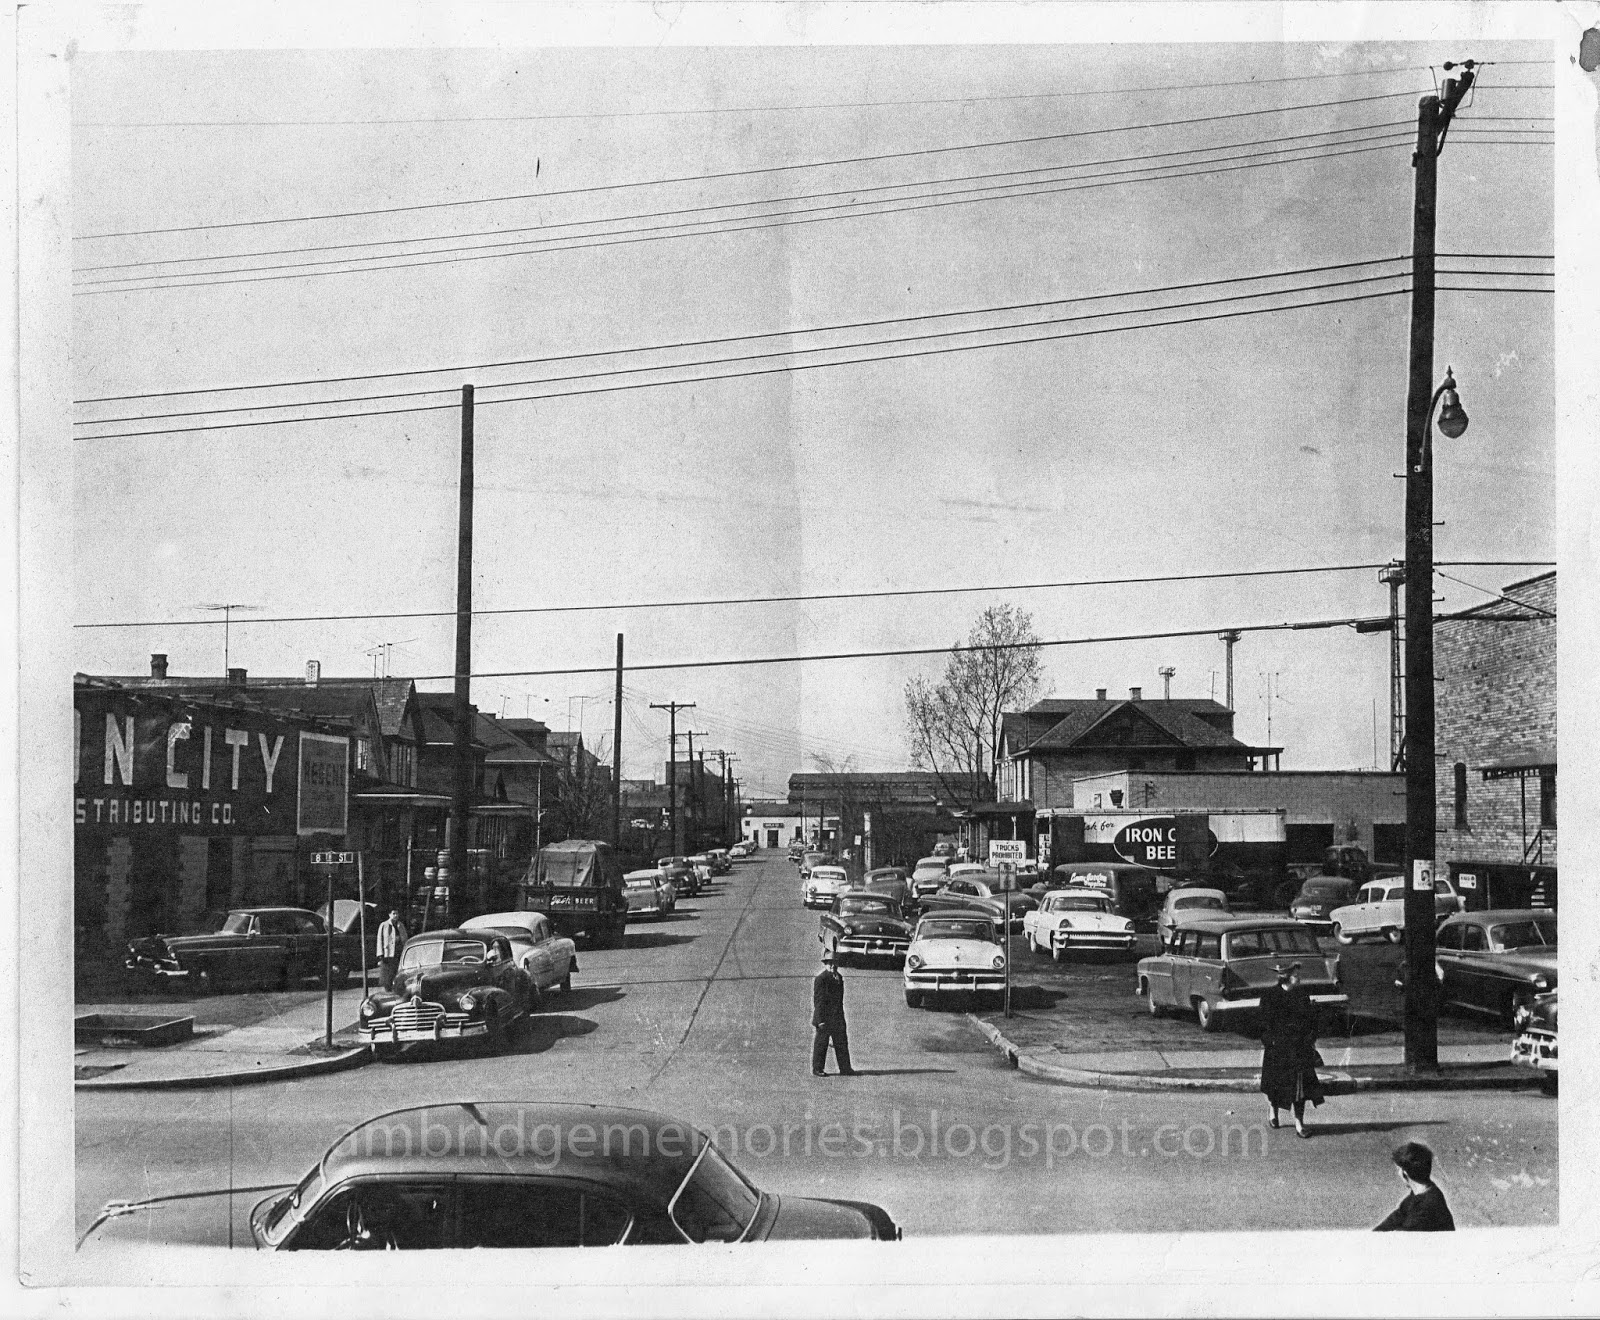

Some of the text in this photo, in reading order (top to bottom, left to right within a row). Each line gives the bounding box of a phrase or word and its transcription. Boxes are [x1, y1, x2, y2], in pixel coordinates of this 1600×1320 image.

[166, 722, 285, 793] CITY
[75, 799, 236, 824] STRIBUTING CO.
[1100, 820, 1115, 831] for
[1125, 828, 1163, 843] IRON
[315, 853, 321, 862] 8
[992, 851, 1023, 859] PROHIBITED
[1146, 845, 1176, 860] BEE
